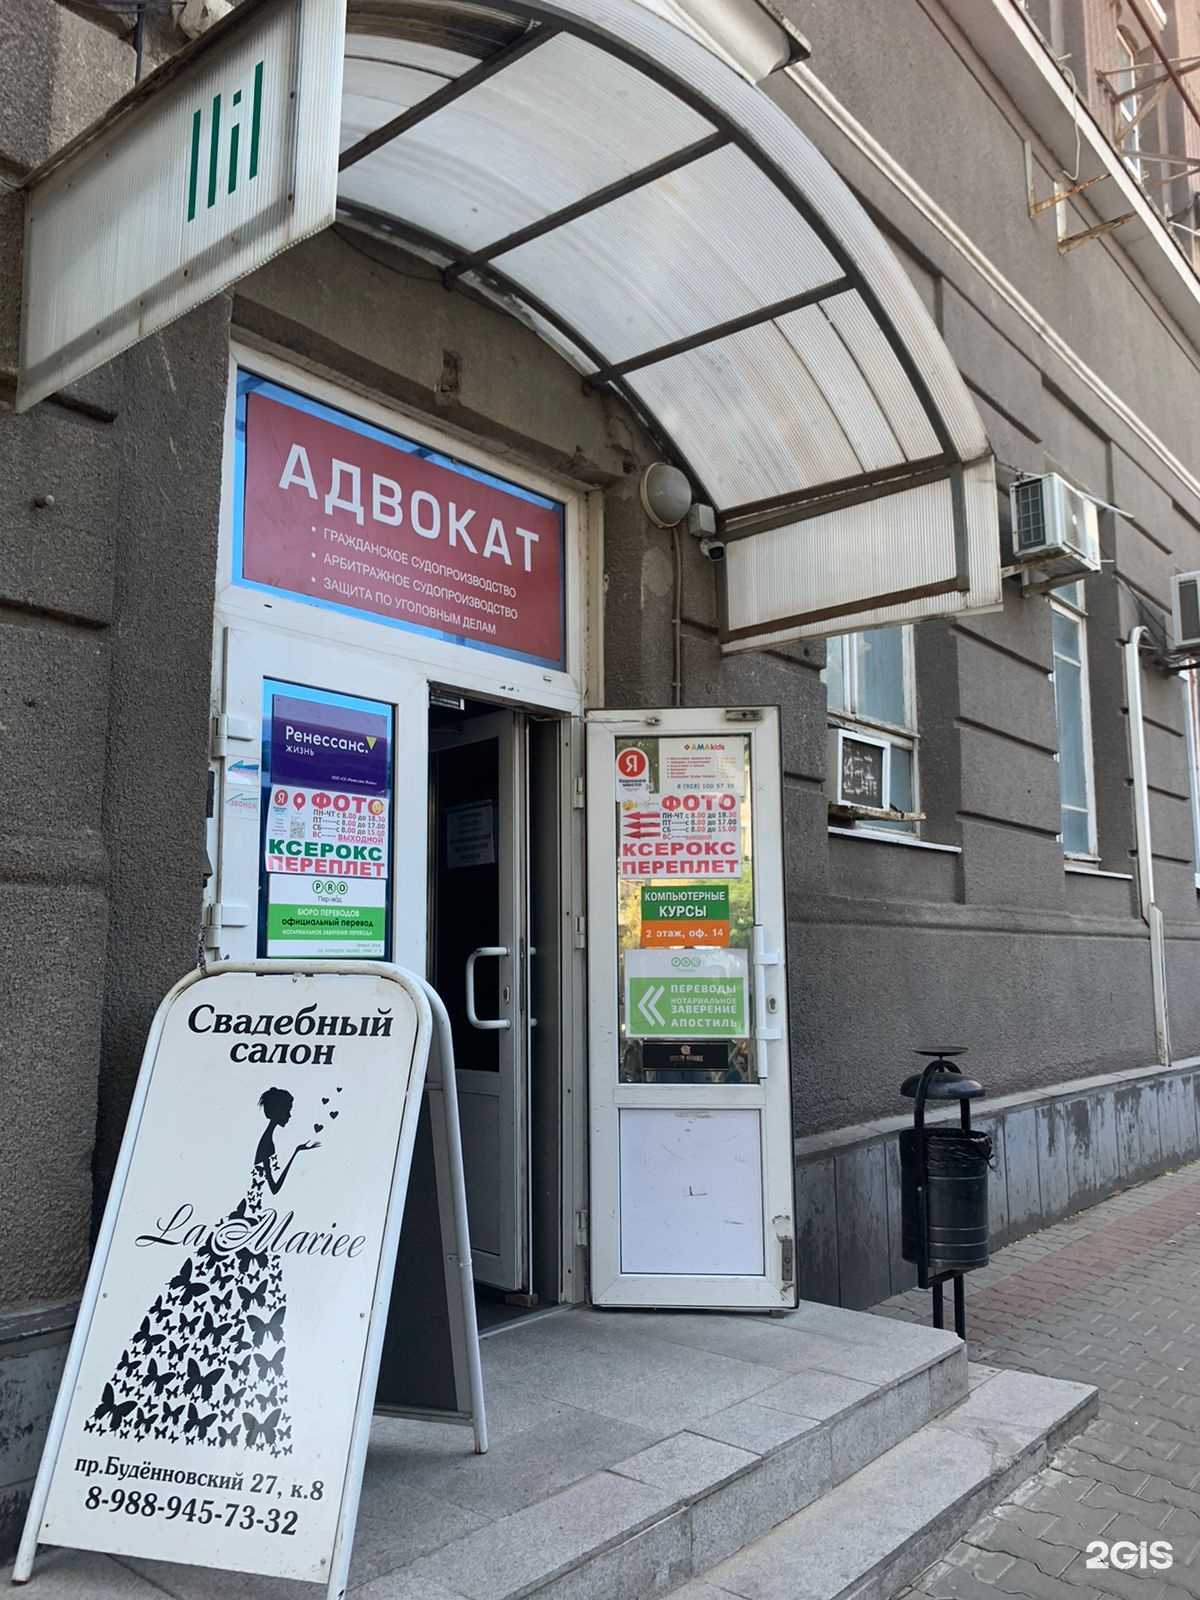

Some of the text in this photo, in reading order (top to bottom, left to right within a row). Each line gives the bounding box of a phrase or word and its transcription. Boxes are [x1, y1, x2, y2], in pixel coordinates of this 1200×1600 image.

[278, 443, 540, 572] АДВОКАТ
[324, 527, 517, 599] ГРАЖДАНСКОЕ СУДОПРОИЗВОДСТВО
[324, 553, 518, 620] АРБИТРАЖНОЕ СУДОПРОИЗВОДСТВО
[323, 577, 497, 635] ЗАЩИТА ПО УГОЛОВНЫМ ДЕЛАМ
[311, 792, 385, 816] ФОТО
[661, 794, 737, 812] ФОТО
[338, 834, 384, 845] ВЫХОДНОЙ
[268, 839, 383, 861] КСЕРОКС
[622, 842, 736, 856] КСЕРОКС
[268, 855, 385, 877] ПЕРЕПЛЕТ
[622, 860, 739, 875] ПЕРЕПЛЕТ
[314, 881, 347, 894] PRO
[645, 891, 725, 902] КОМПЬЮТЕРНЫЕ
[297, 908, 360, 917] БЮРО ПЕРЕВОДОВ
[659, 905, 707, 917] КУРСЫ
[281, 917, 374, 928] официальный перевод
[646, 928, 724, 940] 2 этаж, оф. 14
[671, 985, 737, 995] ПЕРЕВОДЫ
[671, 1005, 737, 1015] ЗАВЕРЕНИЕ
[187, 1003, 394, 1038] Свадебный
[671, 1018, 737, 1028] АПОСТИЛЬ
[229, 1042, 336, 1065] салон
[134, 1203, 367, 1259] La Mariee
[74, 1456, 325, 1501] пр.Будённовский 27, к.8
[84, 1485, 299, 1536] 8-988-945-73-32
